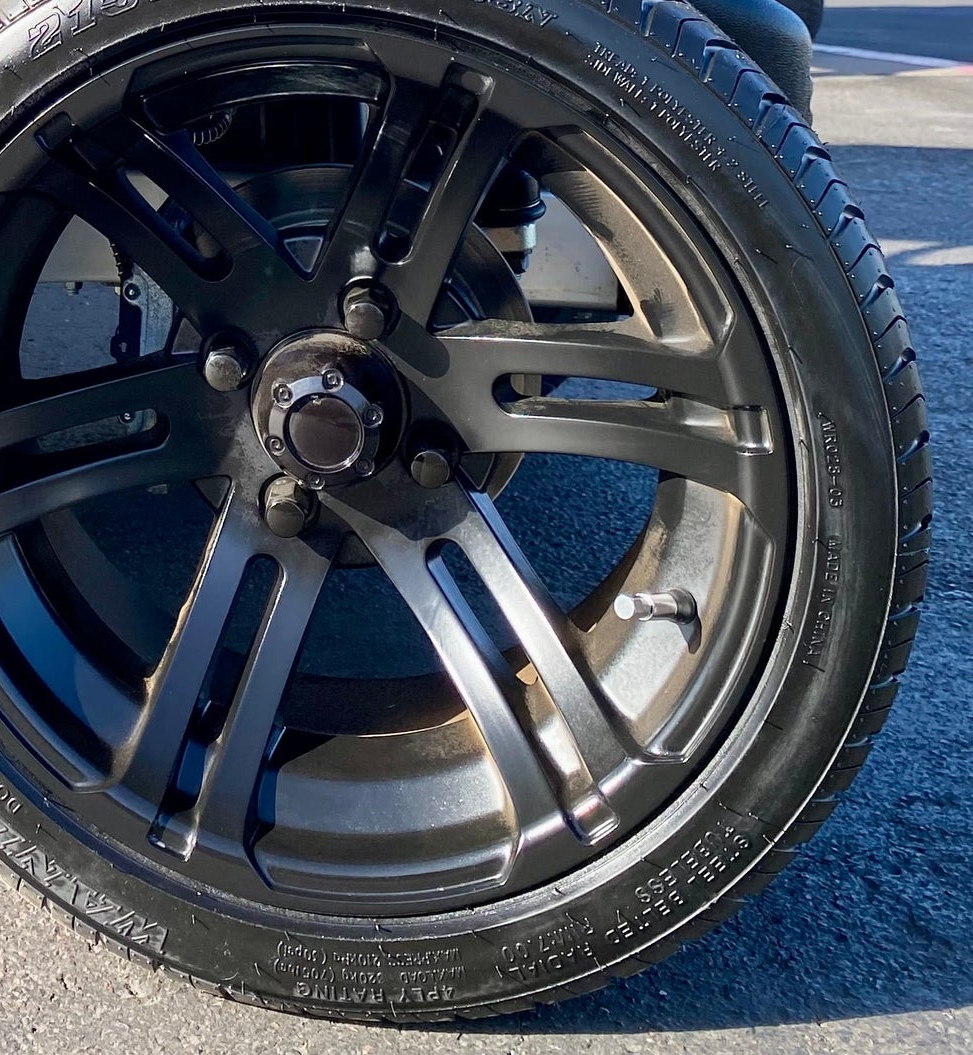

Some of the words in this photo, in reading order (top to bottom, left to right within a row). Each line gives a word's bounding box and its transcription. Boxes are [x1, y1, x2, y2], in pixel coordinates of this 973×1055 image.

[823, 534, 842, 585] MADE
[818, 586, 837, 607] IN
[805, 610, 832, 657] CHINA
[633, 821, 735, 903] TUBELESS
[684, 834, 748, 885] STEEL
[604, 889, 683, 945] BELTED
[506, 941, 592, 980] RADIAL
[293, 980, 384, 1003] RATING
[396, 984, 457, 1003] 4PLY
